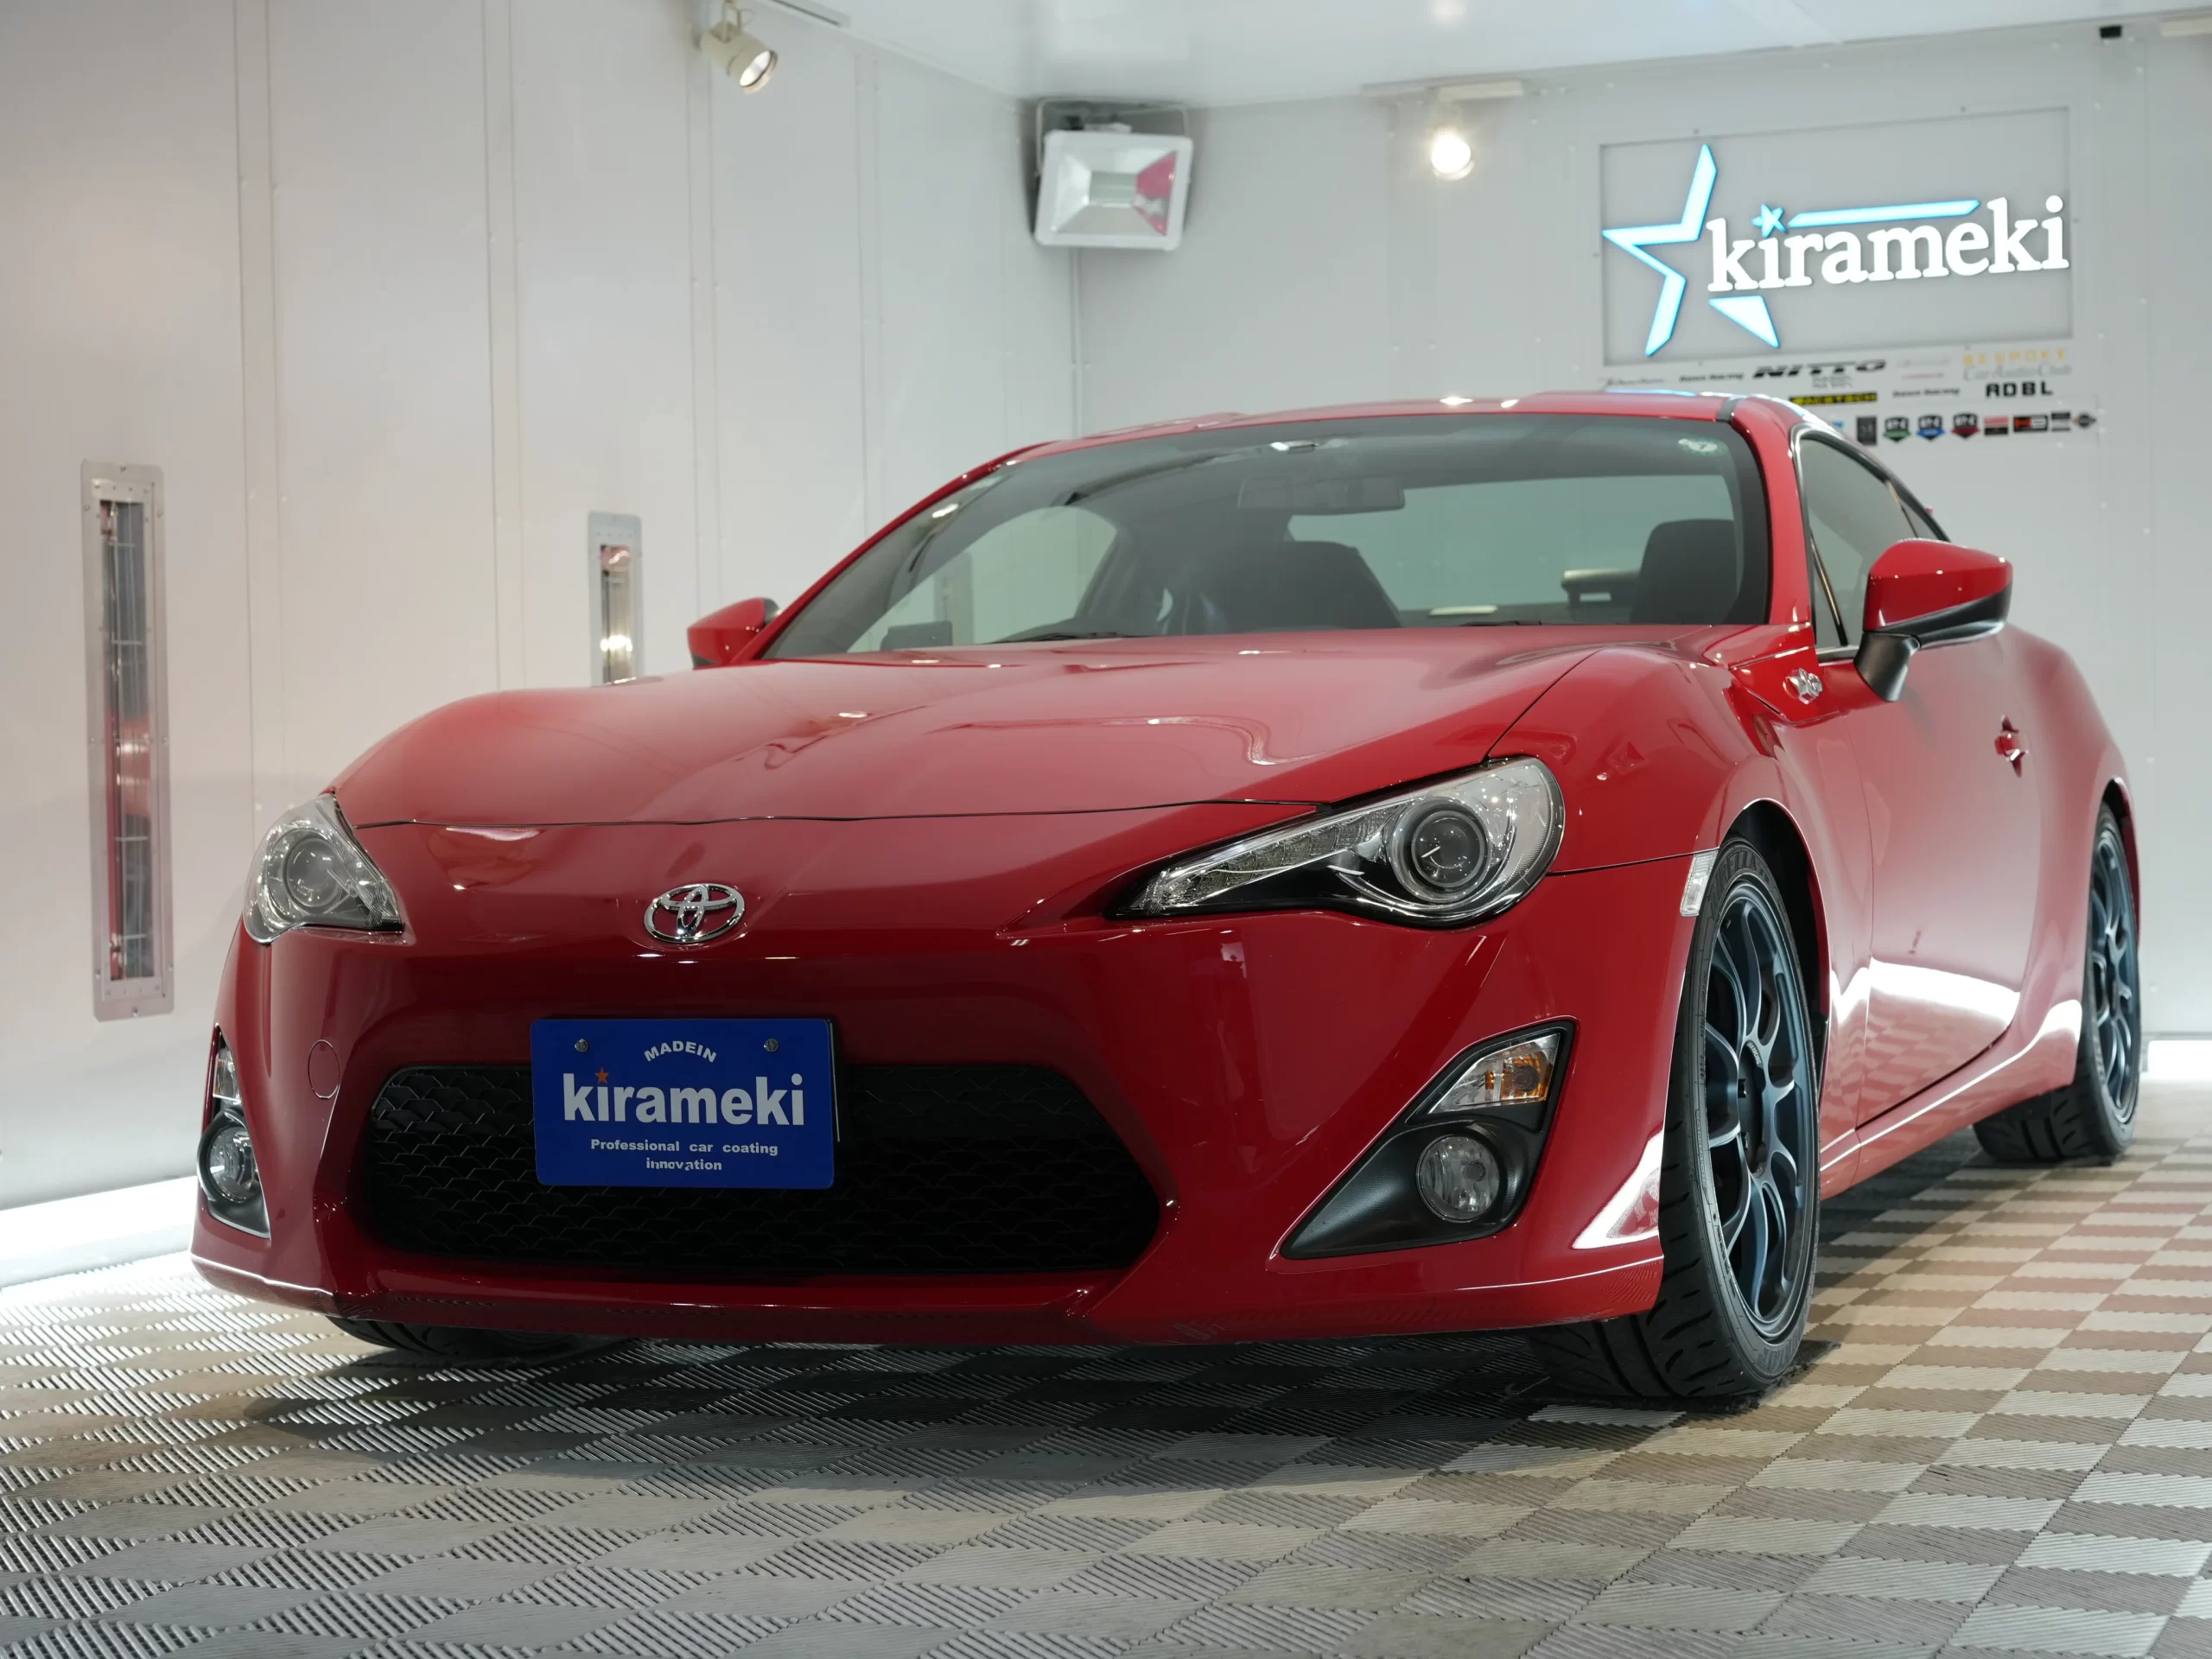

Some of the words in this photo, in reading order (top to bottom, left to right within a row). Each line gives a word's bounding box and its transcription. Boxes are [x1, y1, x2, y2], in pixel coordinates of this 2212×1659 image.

[1706, 194, 2070, 292] kirameki
[1752, 359, 1887, 378] NITTO
[563, 1071, 804, 1126] kirameki
[590, 1139, 680, 1153] Professional
[689, 1142, 713, 1154] car
[722, 1141, 779, 1156] coating
[646, 1157, 722, 1172] innovation
